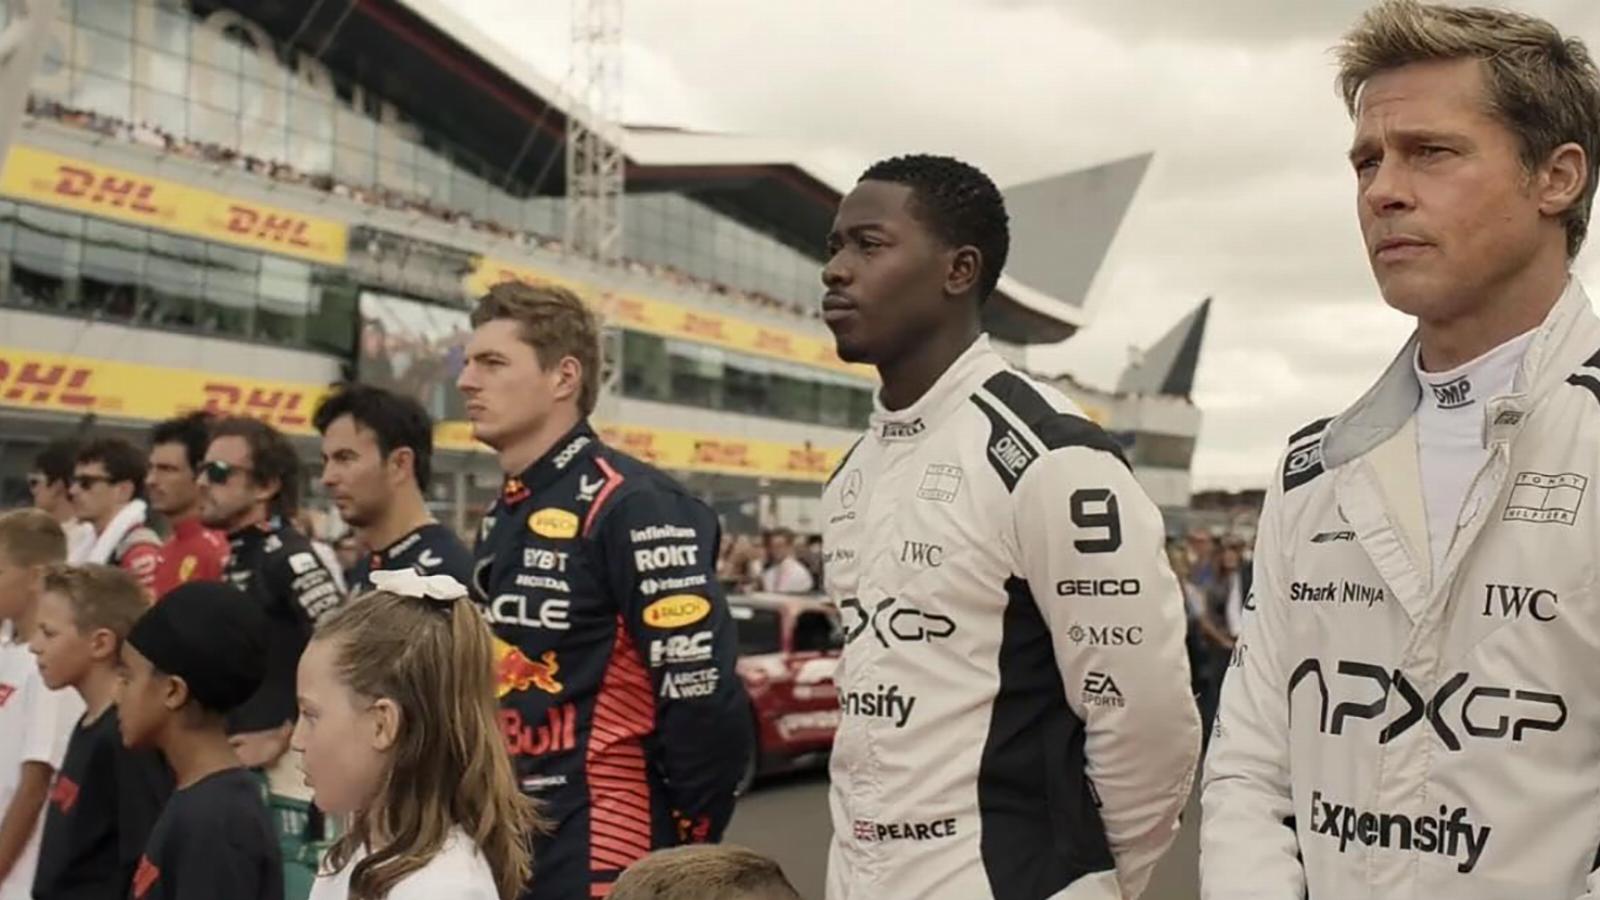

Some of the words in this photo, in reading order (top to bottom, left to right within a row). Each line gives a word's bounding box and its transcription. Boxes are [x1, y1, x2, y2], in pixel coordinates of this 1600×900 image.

[55, 165, 158, 214] DHL
[227, 206, 310, 247] DHL
[0, 359, 96, 405] HL
[1432, 380, 1471, 404] OMP
[204, 385, 306, 424] DHL
[995, 437, 1027, 469] OMP
[1070, 488, 1122, 554] 9
[901, 540, 943, 567] IWC
[1057, 579, 1140, 597] GEICO
[1290, 582, 1337, 601] Shark
[1481, 584, 1559, 622] IWC
[650, 631, 713, 662] HRC
[1089, 627, 1143, 645] MSC
[674, 667, 720, 684] ARCTIC
[679, 682, 717, 698] WOLF
[1084, 671, 1122, 696] EA
[1288, 658, 1567, 750] APXGP
[495, 702, 577, 756] Bull
[876, 818, 957, 841] PEARCE
[1311, 791, 1491, 873] Expensify
